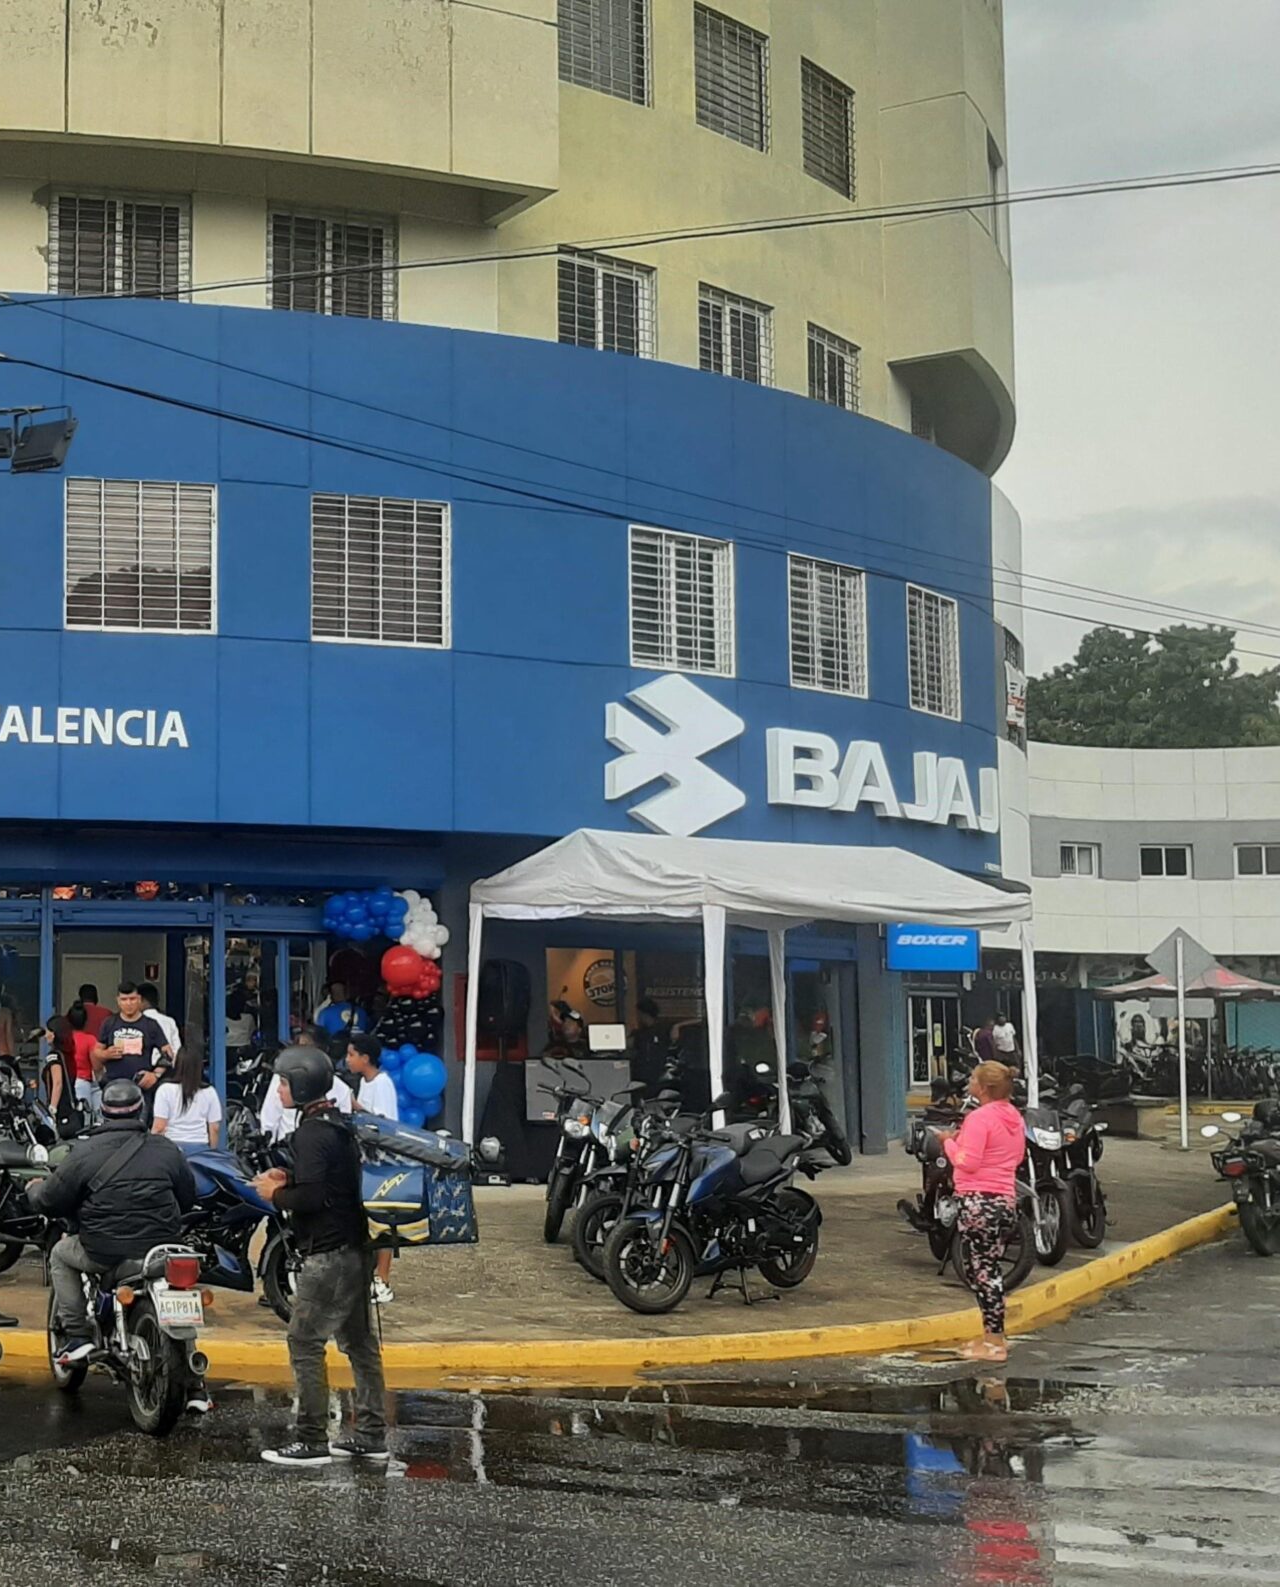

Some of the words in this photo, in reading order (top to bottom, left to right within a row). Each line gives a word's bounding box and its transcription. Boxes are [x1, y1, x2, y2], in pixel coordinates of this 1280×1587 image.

[766, 727, 999, 833] BAJAJ
[897, 934, 968, 946] BOXER
[986, 969, 1068, 981] BICICTAS
